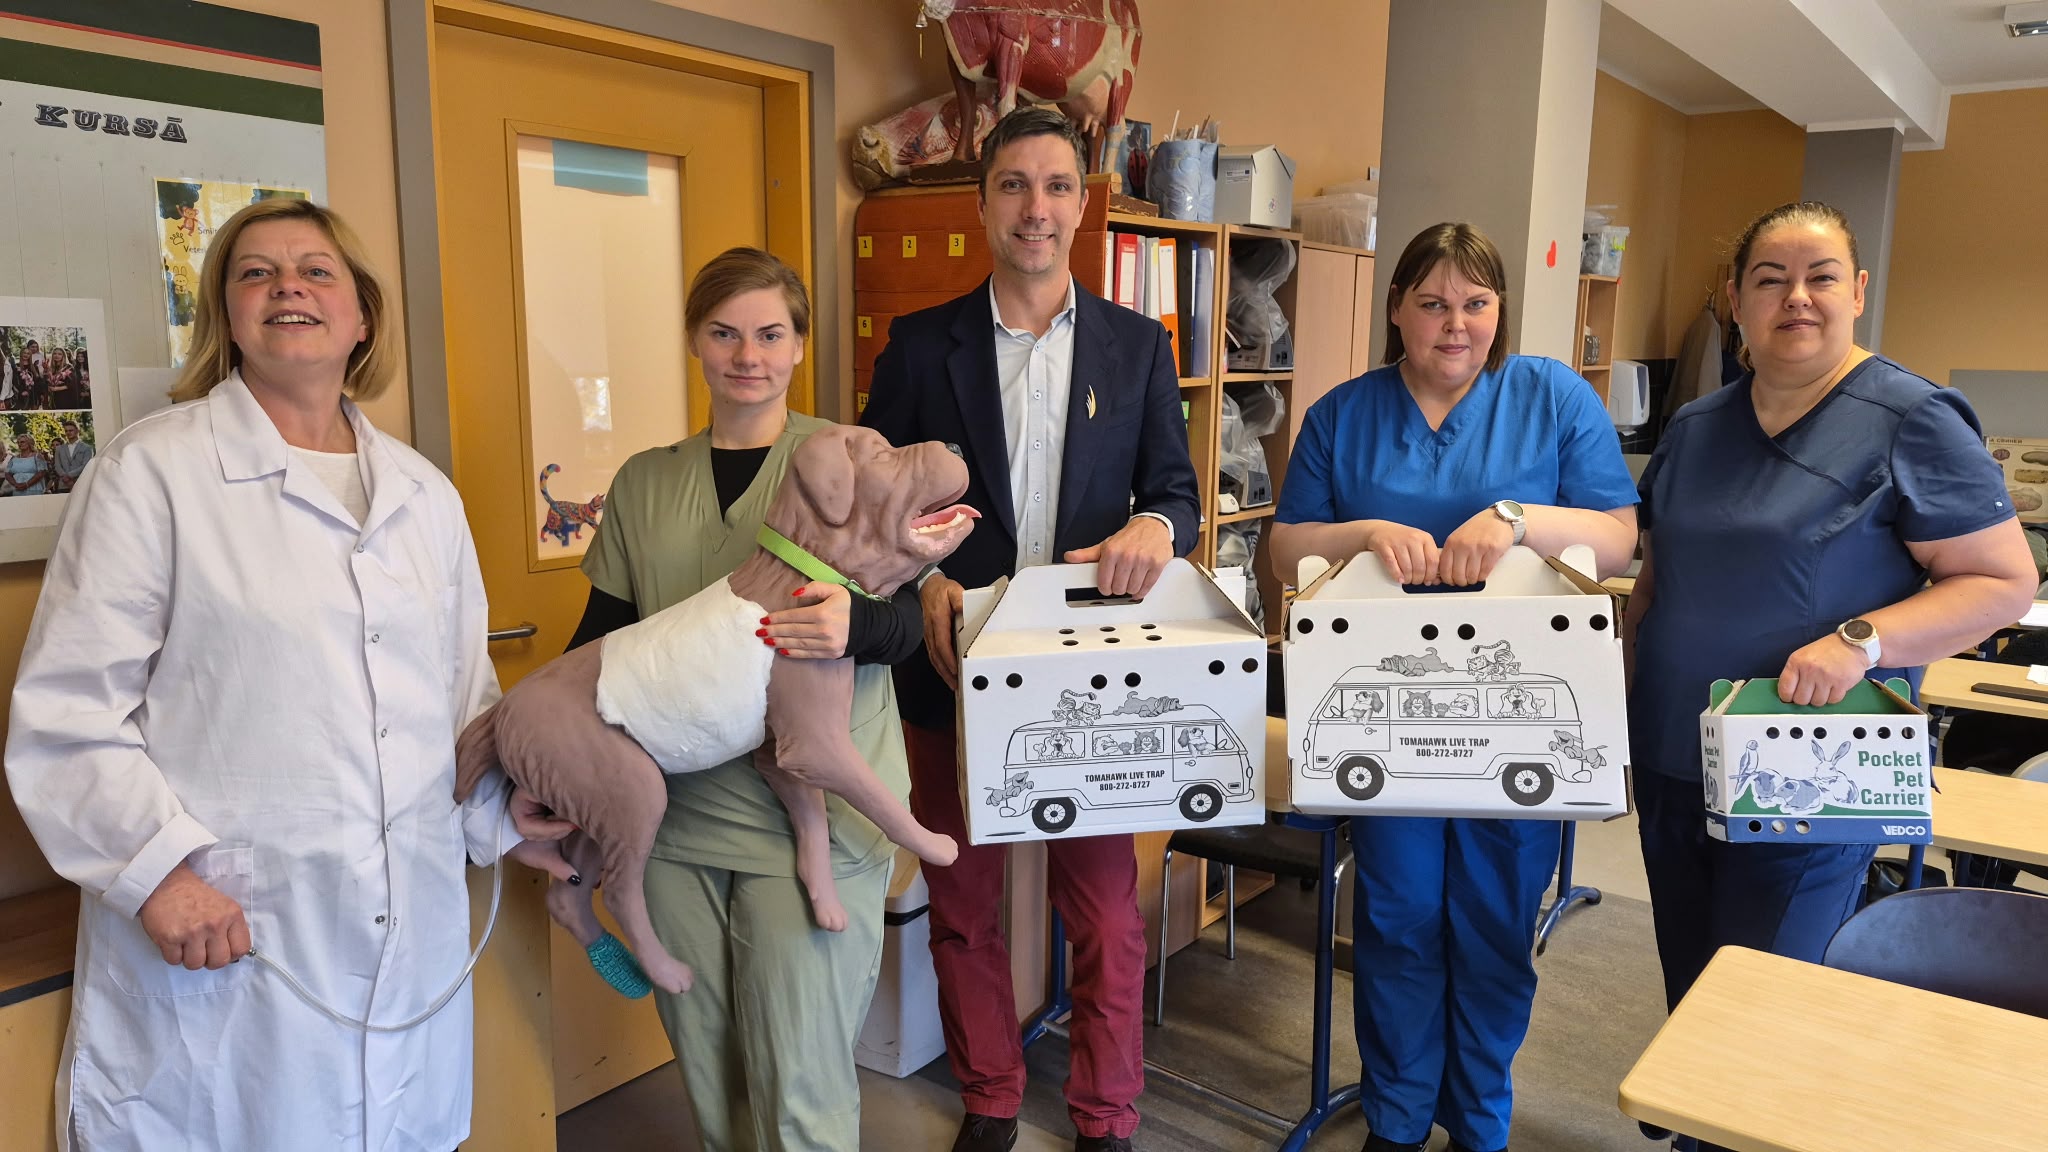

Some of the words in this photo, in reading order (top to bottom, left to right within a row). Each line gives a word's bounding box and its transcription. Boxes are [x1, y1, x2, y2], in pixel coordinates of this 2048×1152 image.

[34, 104, 187, 143] KURSĀ
[863, 239, 868, 249] 1
[907, 239, 912, 249] 2
[954, 237, 959, 247] 3
[862, 319, 867, 328] 6
[1399, 737, 1448, 747] TOMAHAWK
[1449, 738, 1466, 747] LIVE
[1468, 738, 1490, 747] TRAP
[1416, 748, 1473, 758] 800-272-8727
[1858, 750, 1922, 767] Pocket
[1085, 772, 1128, 782] TOMAHAWK
[1129, 771, 1145, 780] LIVE
[1146, 769, 1165, 779] TRAP
[1893, 770, 1924, 787] Pet
[1099, 780, 1150, 791] 800-272-8727
[1861, 788, 1925, 805] Carrier
[1881, 825, 1926, 836] VEDCO
